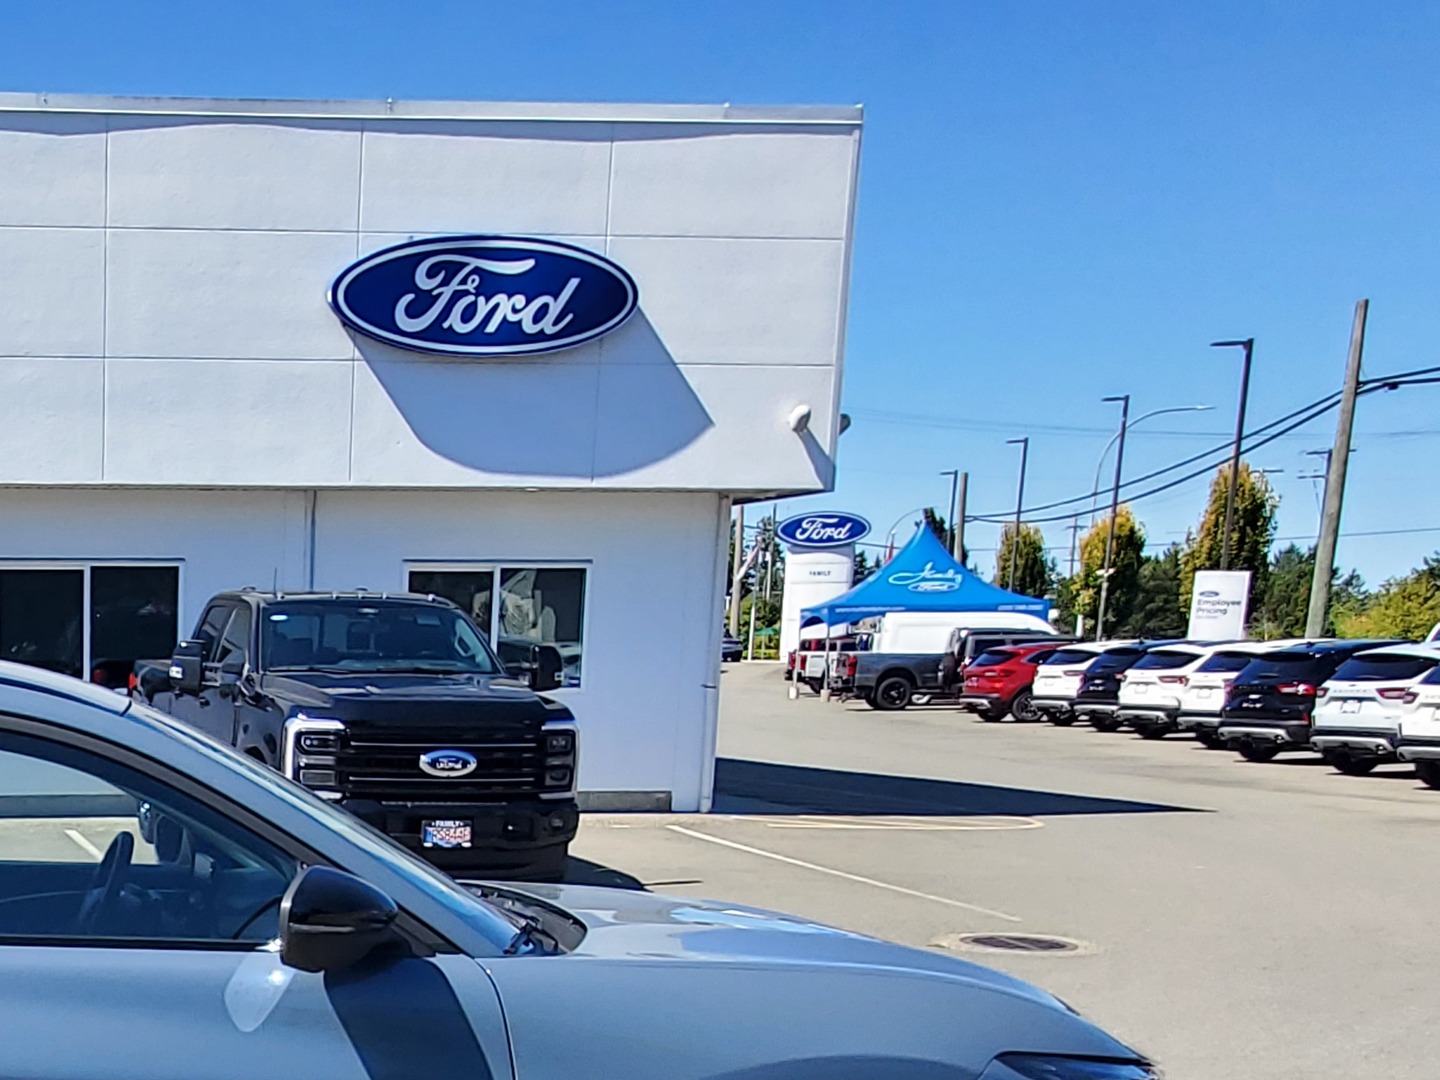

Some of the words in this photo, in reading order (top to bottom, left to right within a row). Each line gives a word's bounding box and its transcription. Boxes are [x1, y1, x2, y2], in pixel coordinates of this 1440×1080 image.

[394, 254, 581, 335] Ford
[795, 517, 853, 540] Ford
[1197, 599, 1242, 607] Employee
